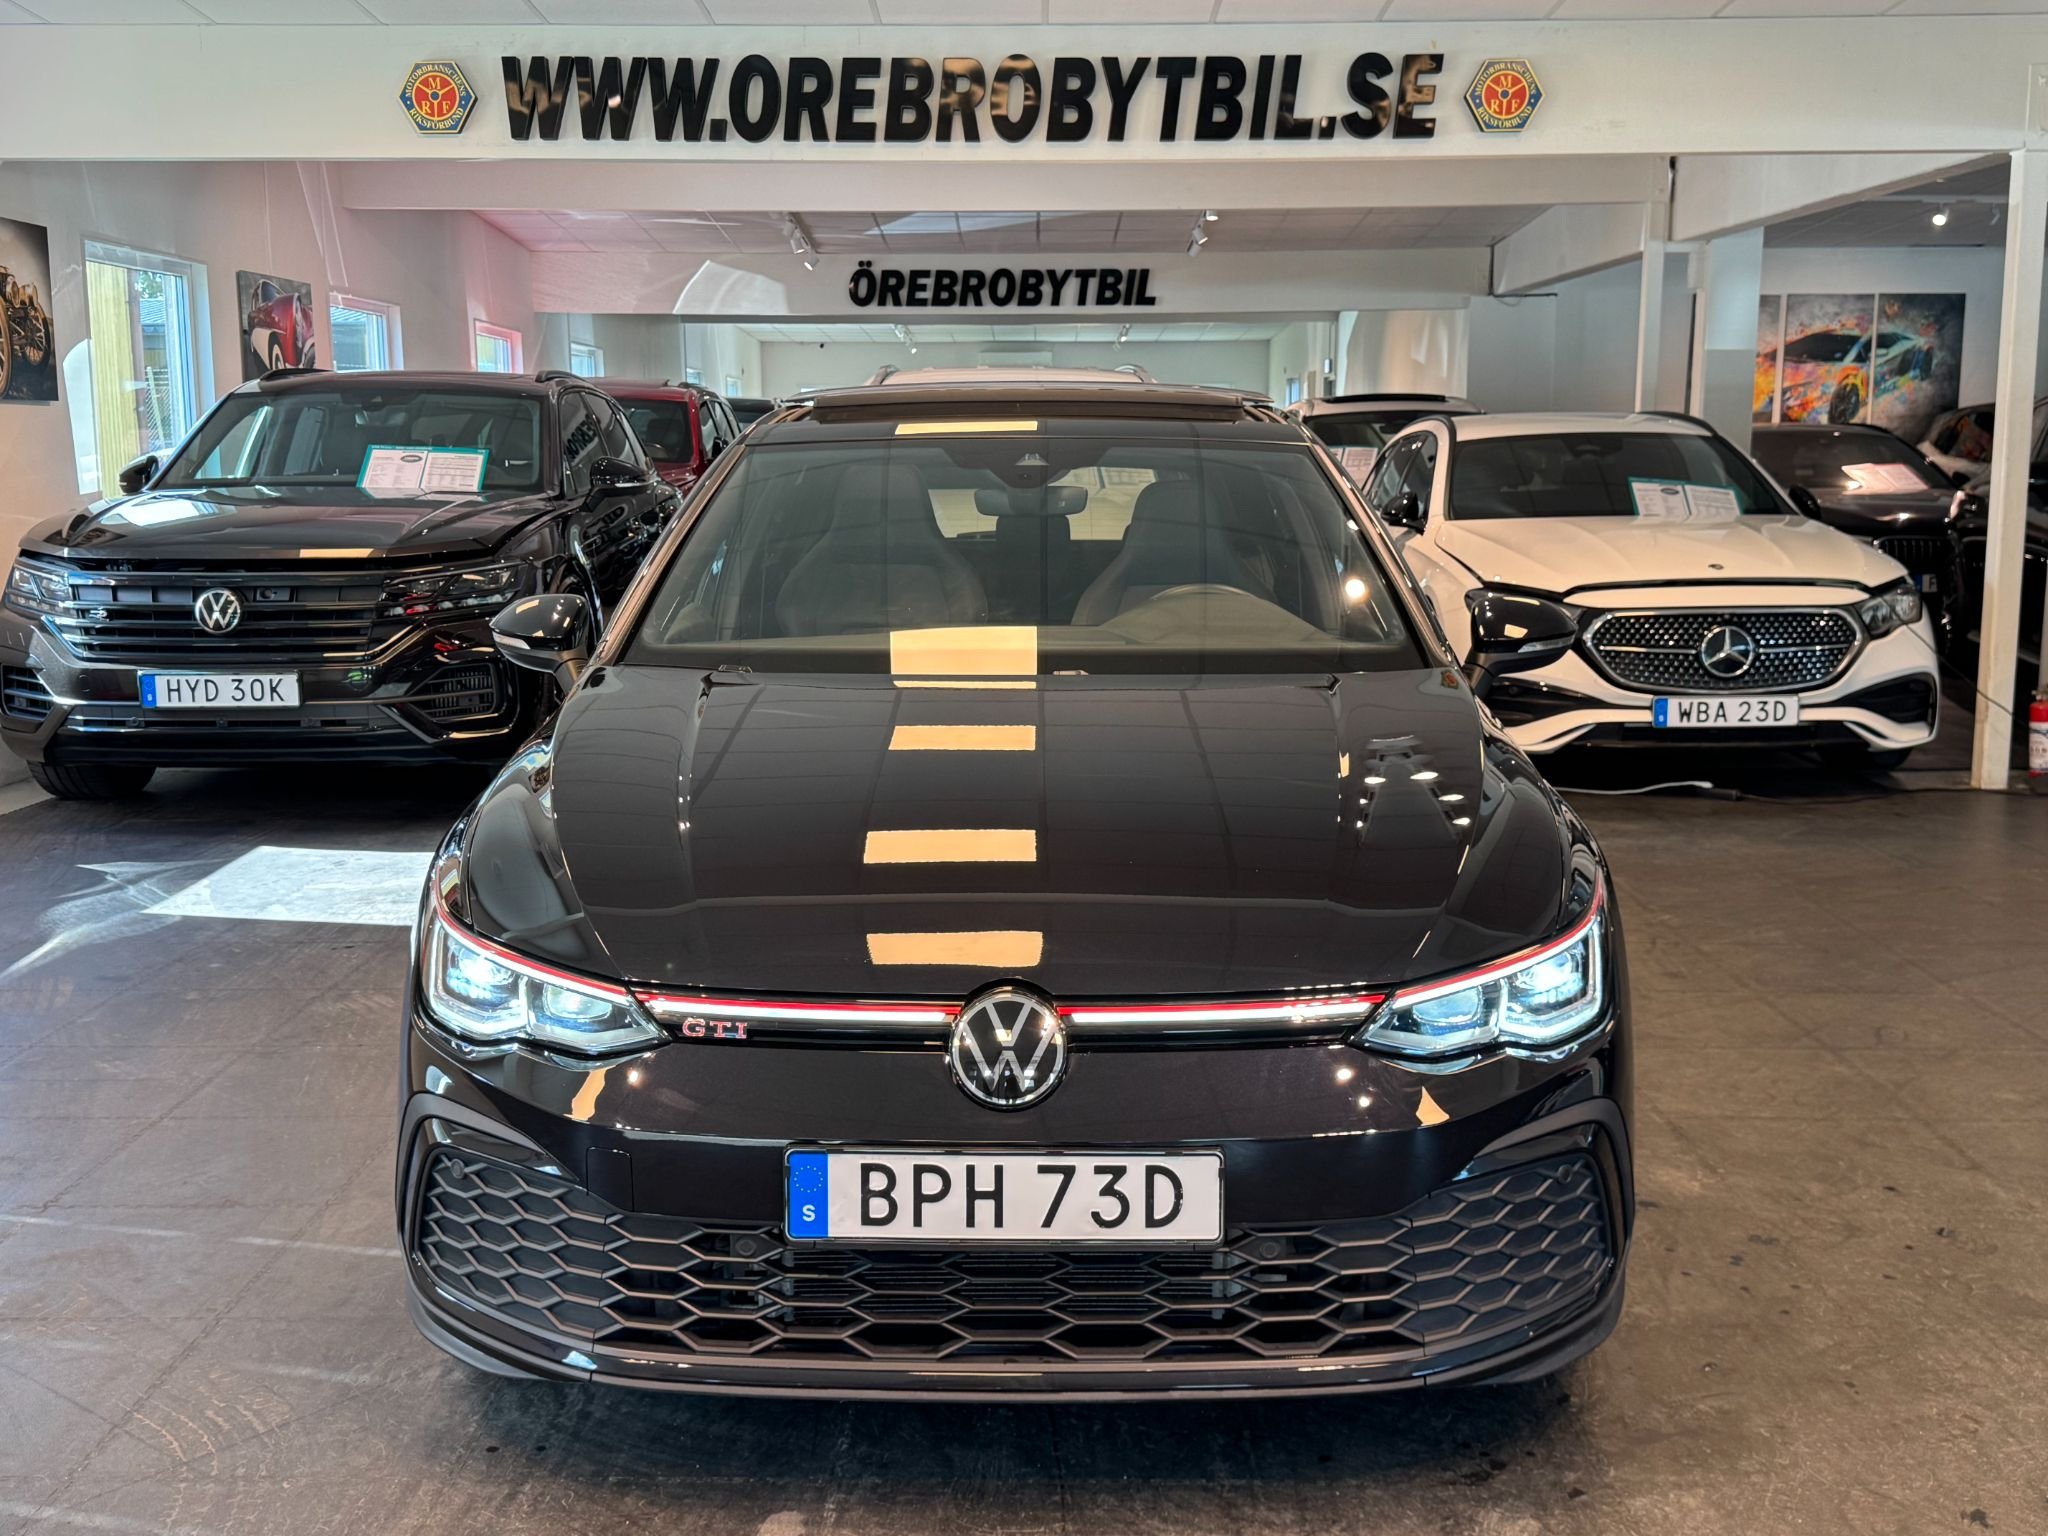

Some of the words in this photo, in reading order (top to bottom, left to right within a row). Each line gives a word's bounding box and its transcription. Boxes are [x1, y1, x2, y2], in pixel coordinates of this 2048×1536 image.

[428, 77, 441, 90] M
[501, 53, 1444, 142] WWW.OREBROBYTBIL.SE
[848, 260, 1157, 307] ÖREBROBYTBIL
[166, 679, 219, 703] HYD
[231, 678, 285, 702] 30K
[1678, 701, 1728, 723] WBA
[1738, 701, 1787, 722] 23D
[682, 1017, 748, 1039] GTI
[802, 1204, 816, 1222] S
[860, 1162, 1004, 1229] BPH
[1037, 1163, 1184, 1229] 73D
